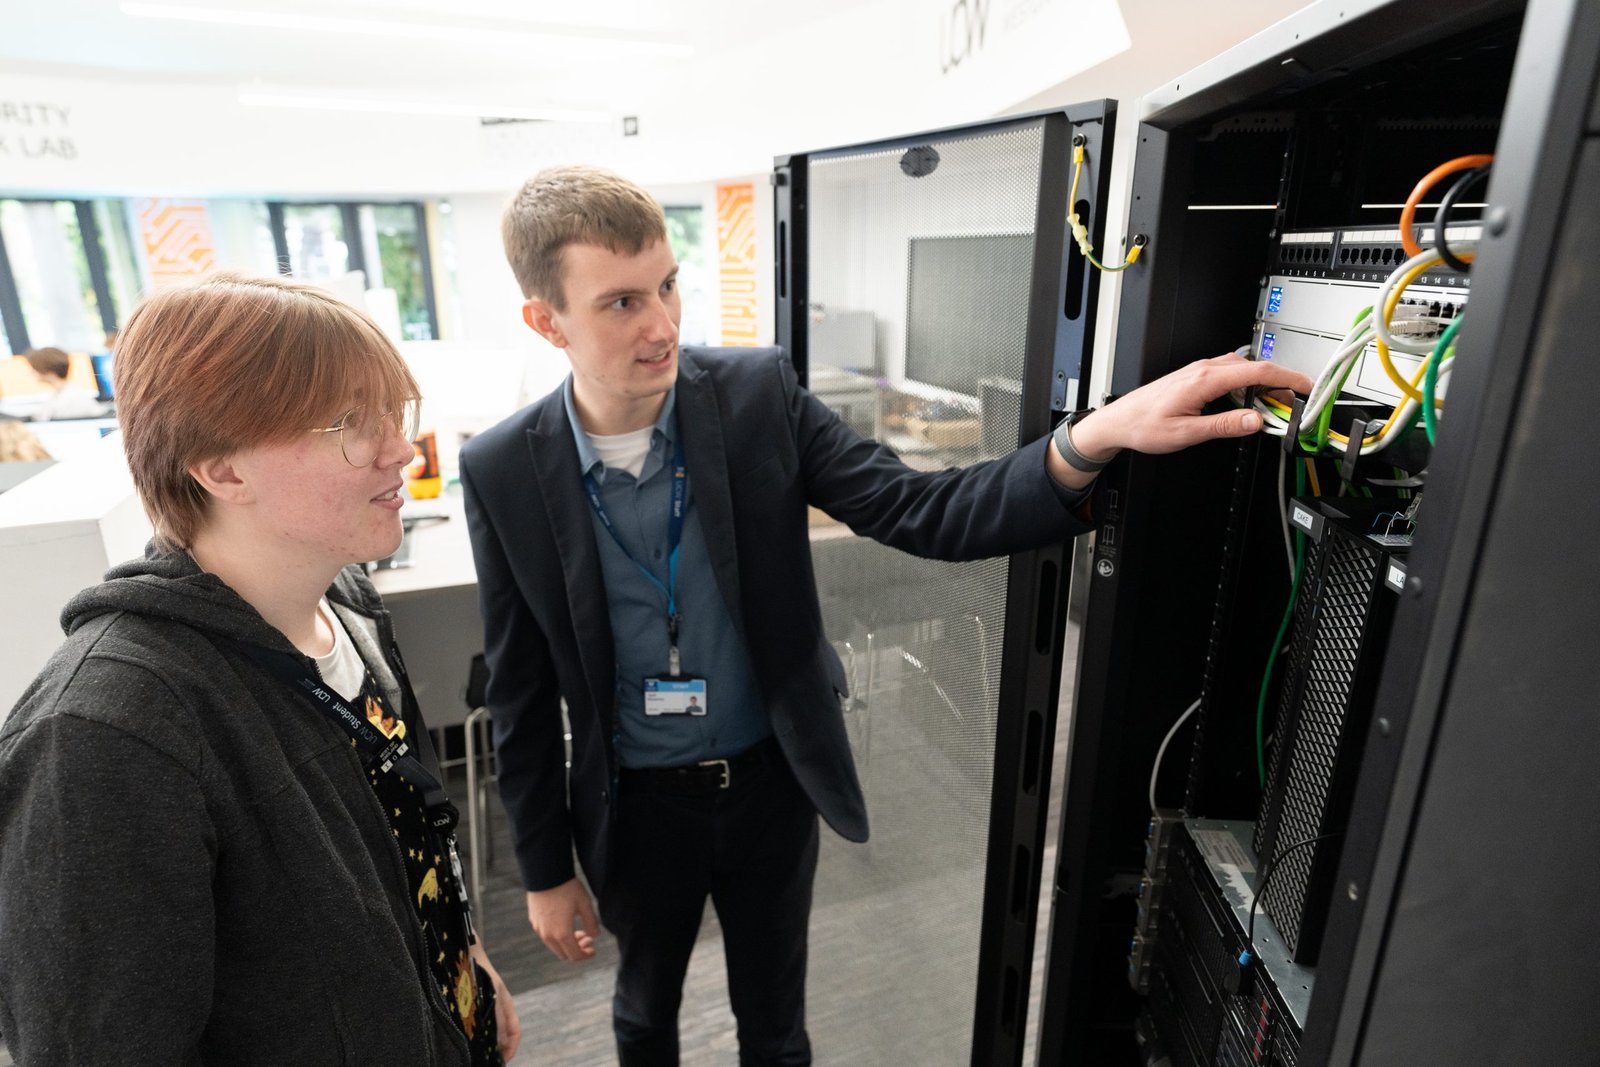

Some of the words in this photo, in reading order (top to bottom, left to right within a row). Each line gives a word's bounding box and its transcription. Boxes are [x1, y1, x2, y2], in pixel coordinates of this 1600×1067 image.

[19, 135, 78, 161] LAB
[1448, 278, 1455, 286] 15
[1463, 279, 1471, 287] 16
[332, 701, 362, 730] Student
